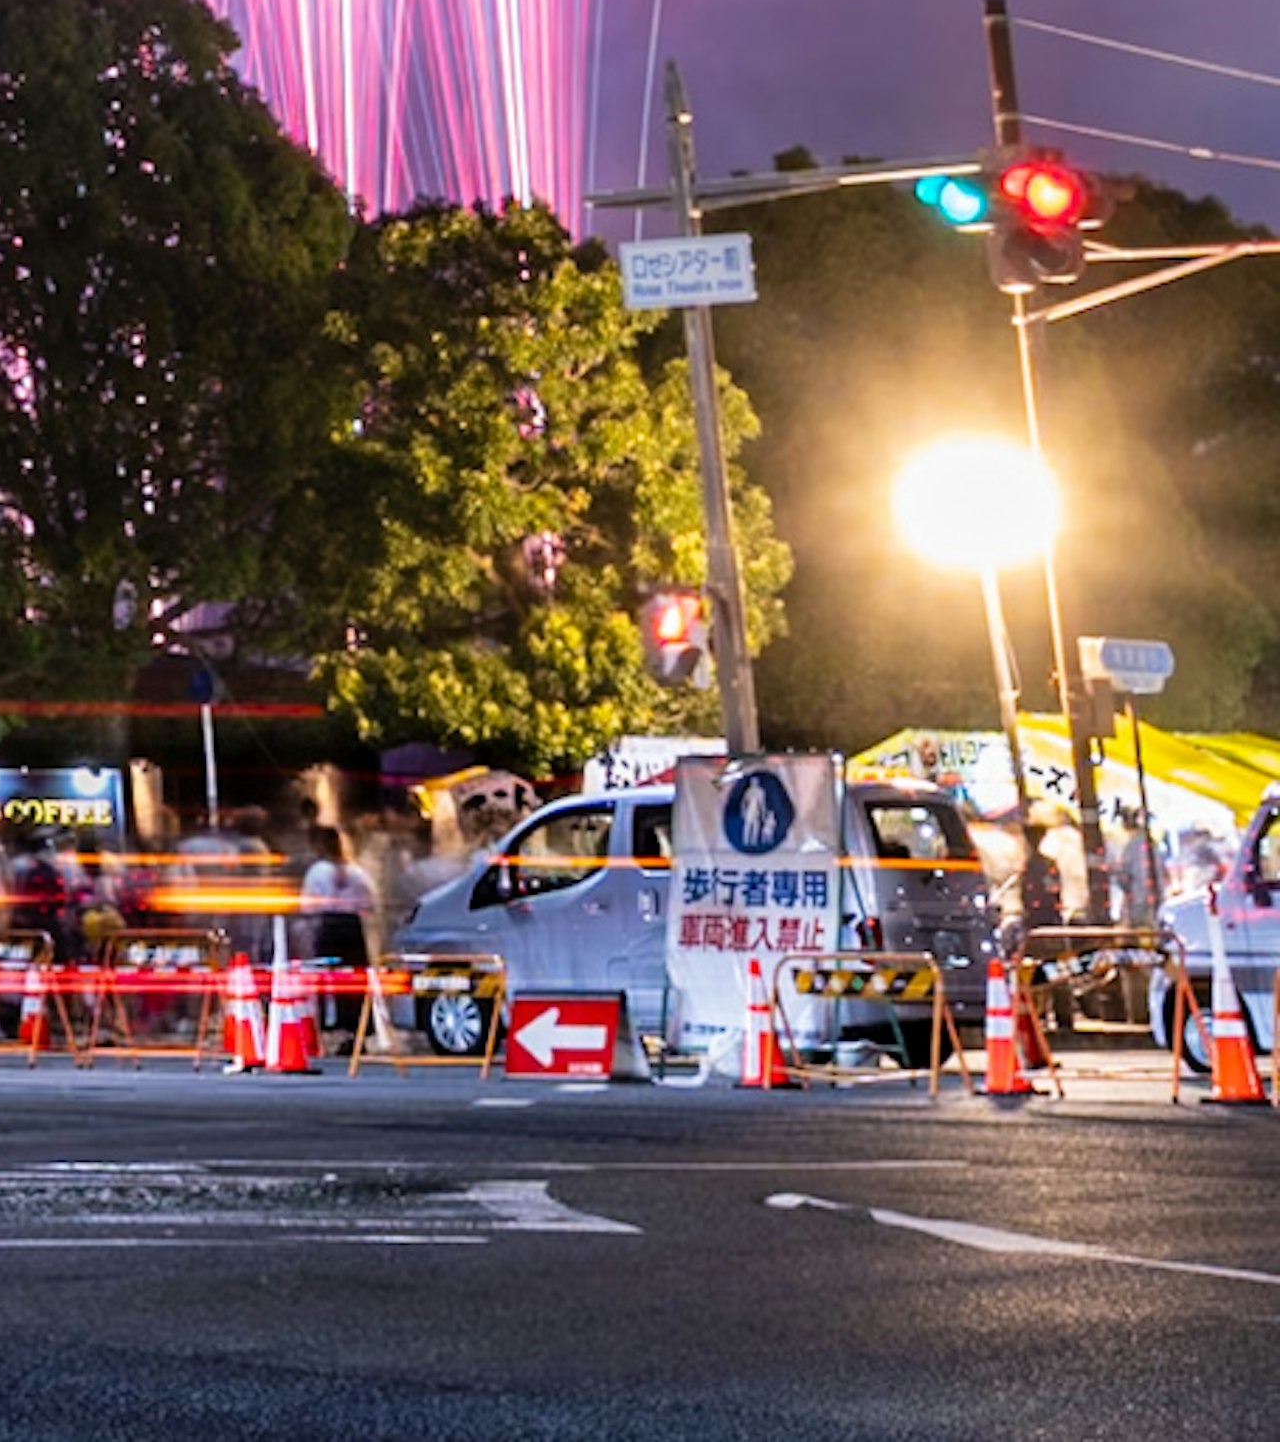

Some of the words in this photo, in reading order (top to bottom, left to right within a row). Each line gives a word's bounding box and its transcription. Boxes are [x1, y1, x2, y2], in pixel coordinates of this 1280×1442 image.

[3, 798, 113, 825] COFFEE
[683, 867, 828, 908] 歩行者専用
[678, 914, 825, 952] 車両進入禁止
